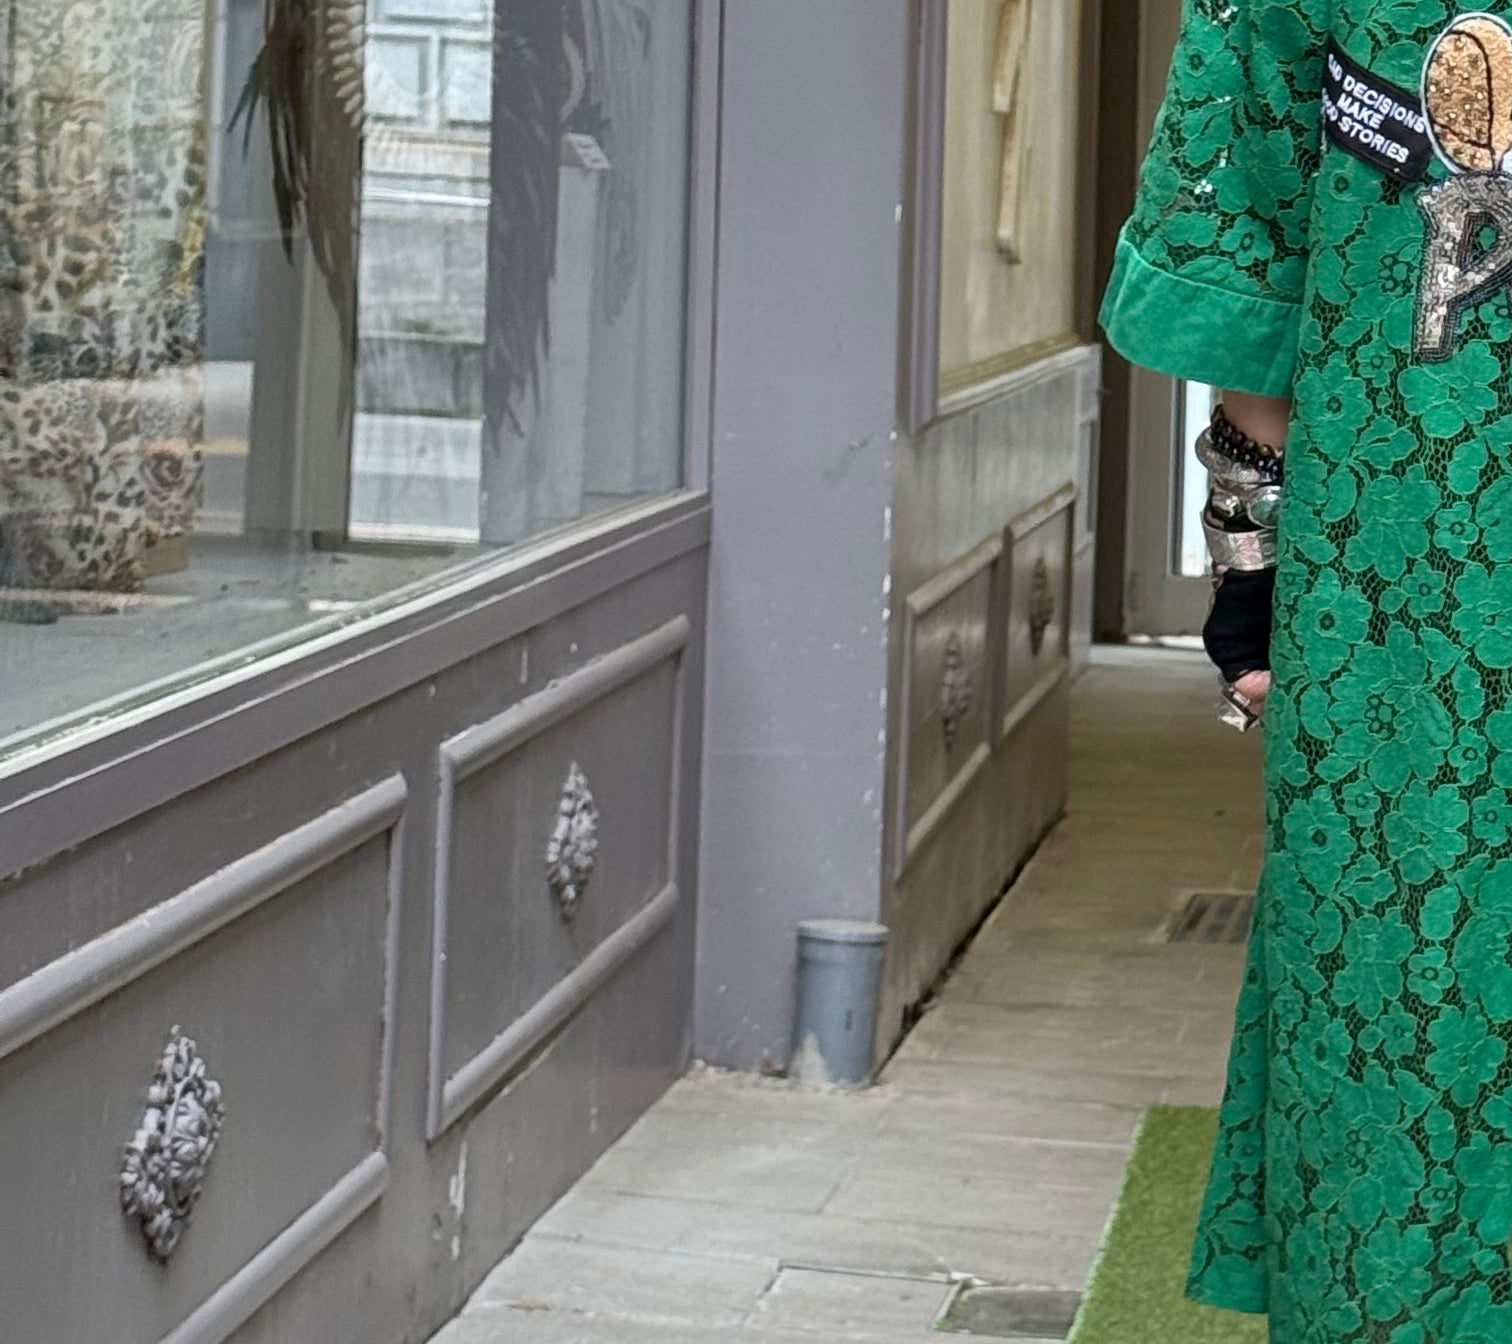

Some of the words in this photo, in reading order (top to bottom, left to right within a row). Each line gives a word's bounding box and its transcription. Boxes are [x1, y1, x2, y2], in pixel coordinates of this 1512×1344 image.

[1337, 93, 1385, 129] MAKE
[1342, 74, 1427, 134] DECISIONS
[1337, 116, 1410, 163] STORIES
